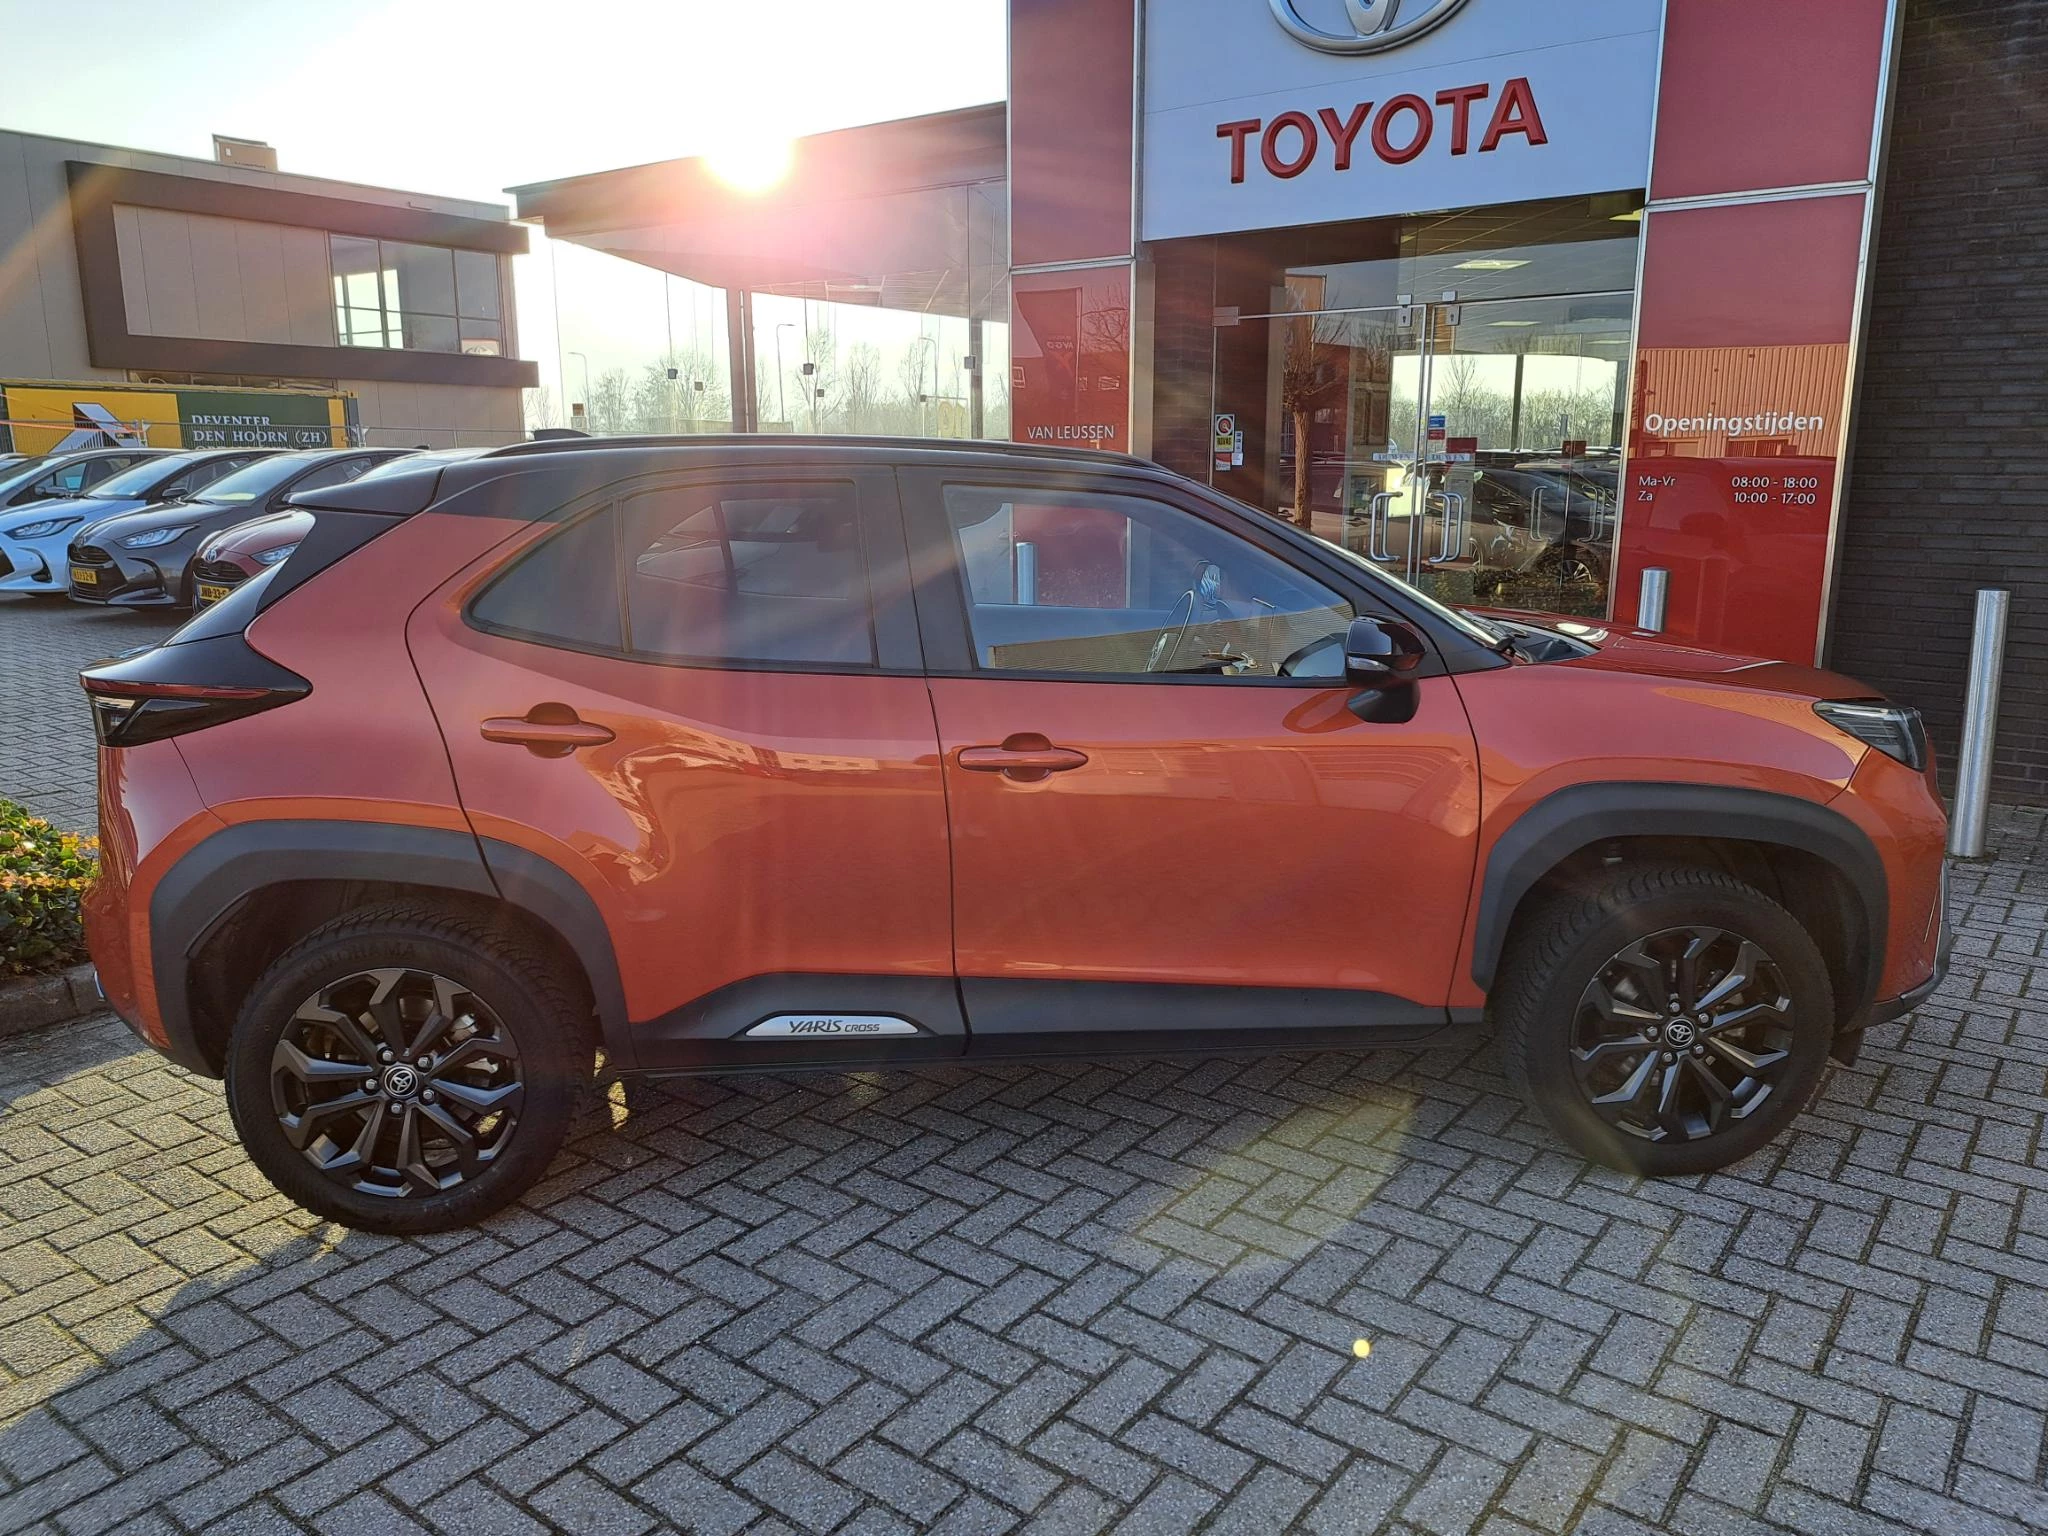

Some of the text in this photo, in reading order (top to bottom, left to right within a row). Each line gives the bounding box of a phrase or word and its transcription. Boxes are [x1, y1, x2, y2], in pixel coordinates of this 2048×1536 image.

[1216, 77, 1548, 184] TOYOTA
[191, 414, 270, 426] DEVENTER
[1645, 411, 1824, 437] Openingstijden
[193, 429, 328, 445] DEN HOORN (ZH)
[1027, 424, 1115, 440] VAN LEUSSEN
[1638, 475, 1676, 488] Ma-Vr
[1731, 476, 1770, 489] 08:00
[1782, 476, 1818, 490] 18:00
[1638, 490, 1653, 502] Za
[1733, 492, 1768, 504] 10:00
[1781, 492, 1816, 505] 17:00
[789, 1019, 881, 1034] YARIS CROSS
